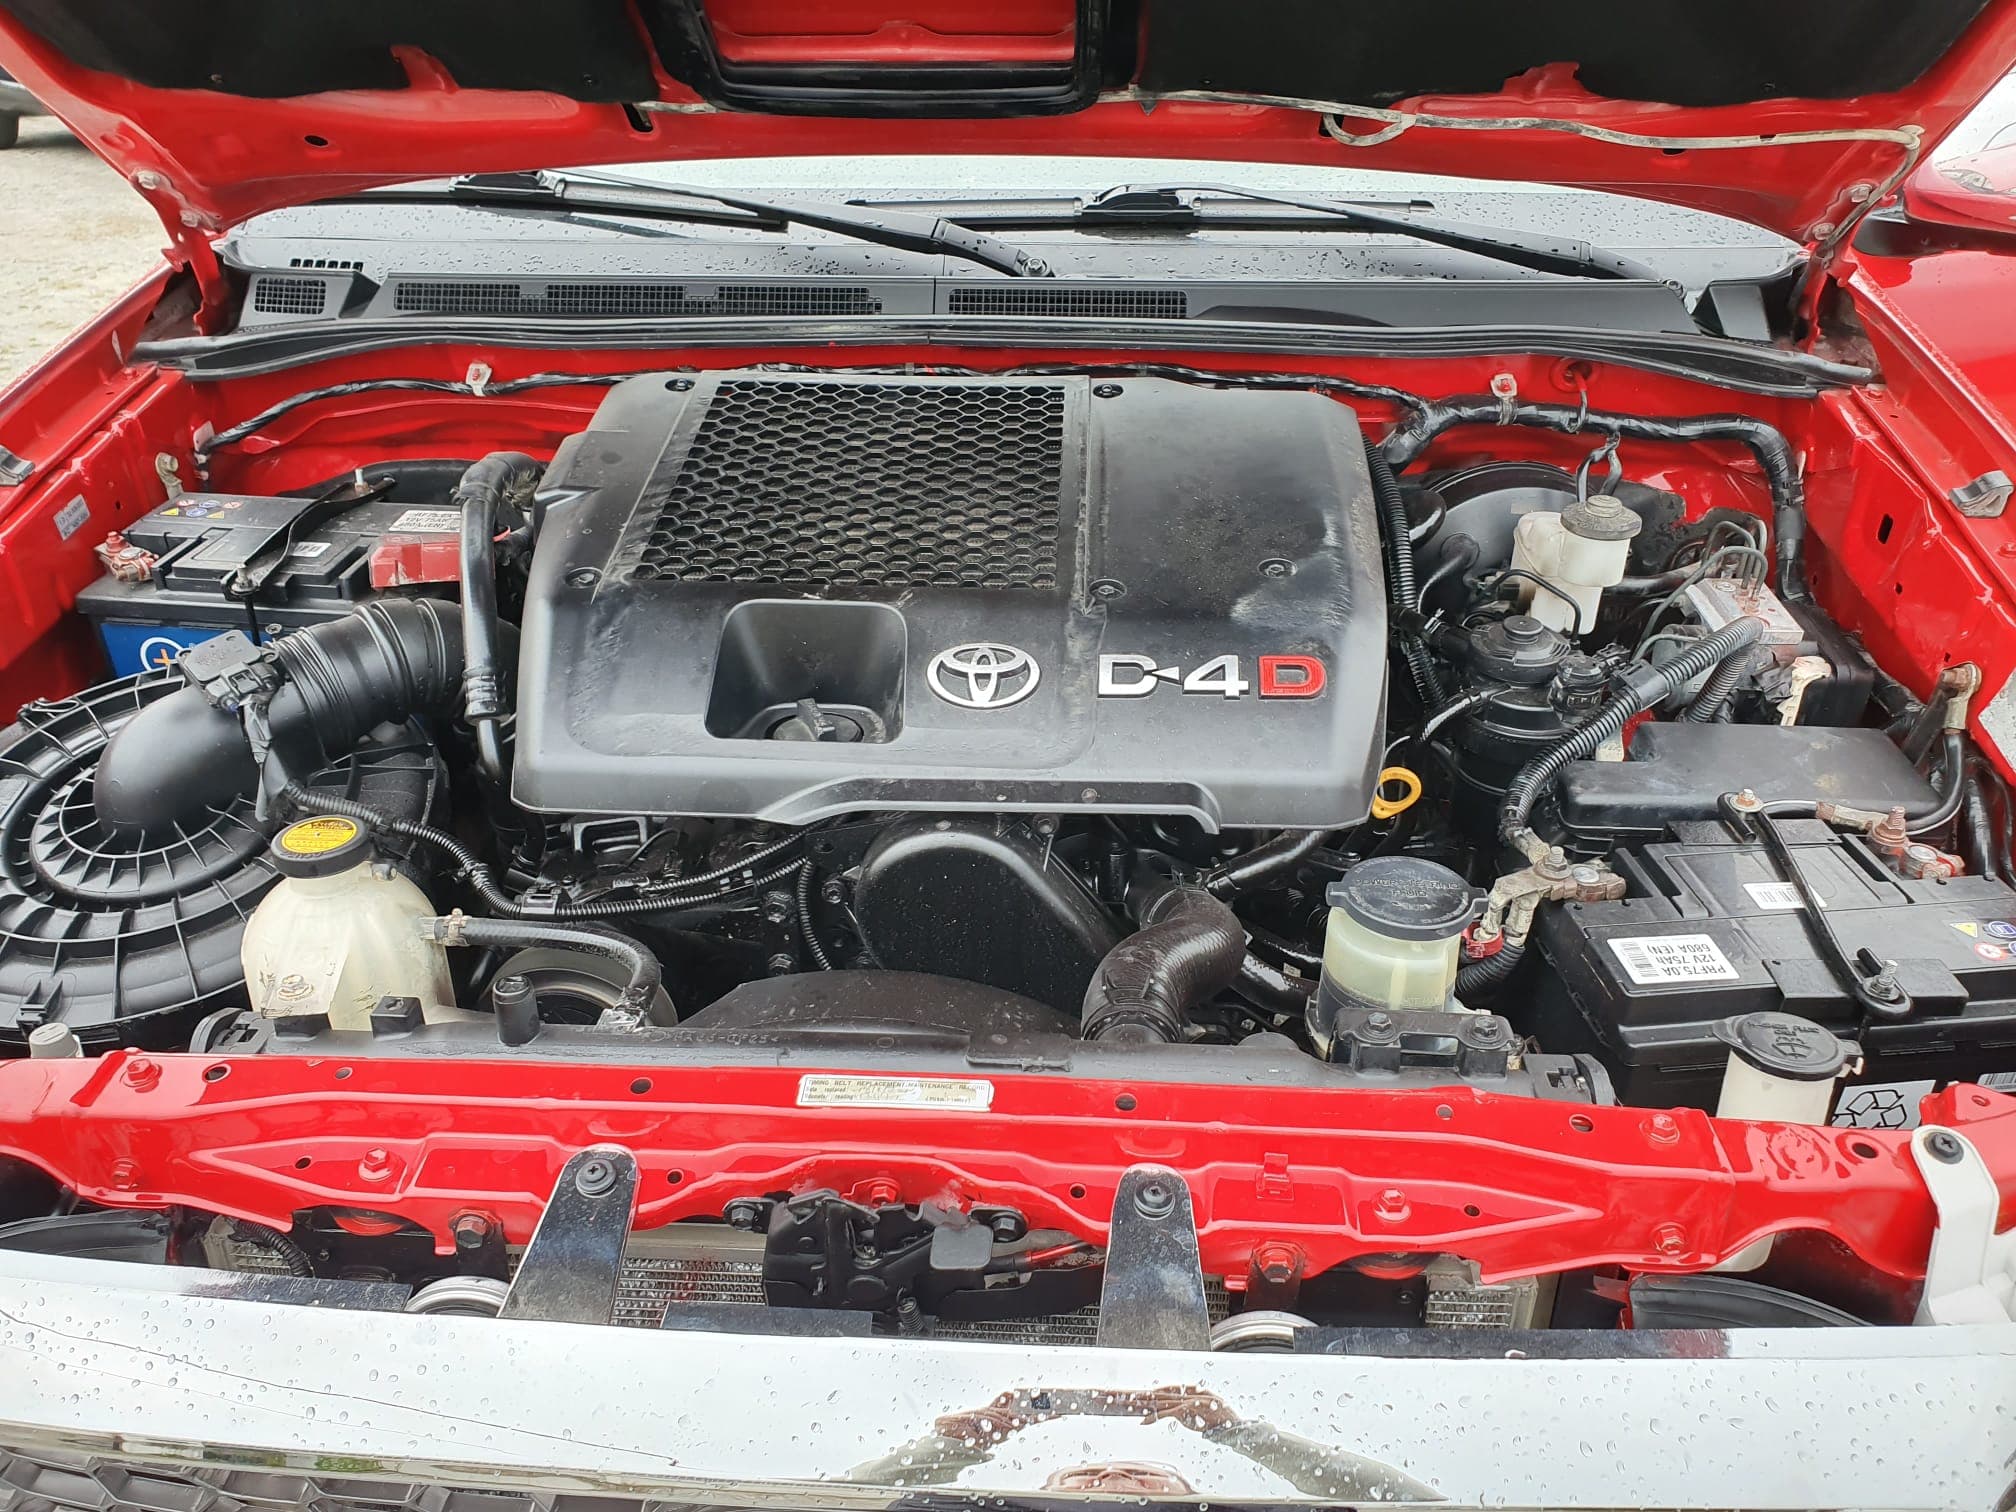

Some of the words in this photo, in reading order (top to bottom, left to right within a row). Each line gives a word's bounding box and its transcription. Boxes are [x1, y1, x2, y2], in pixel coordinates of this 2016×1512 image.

[1646, 944, 1674, 955] (EN)
[1678, 943, 1711, 953] 680A
[1656, 955, 1687, 965] 75Ah
[1693, 953, 1716, 963] 12V
[1663, 965, 1727, 977] PRF75.0A
